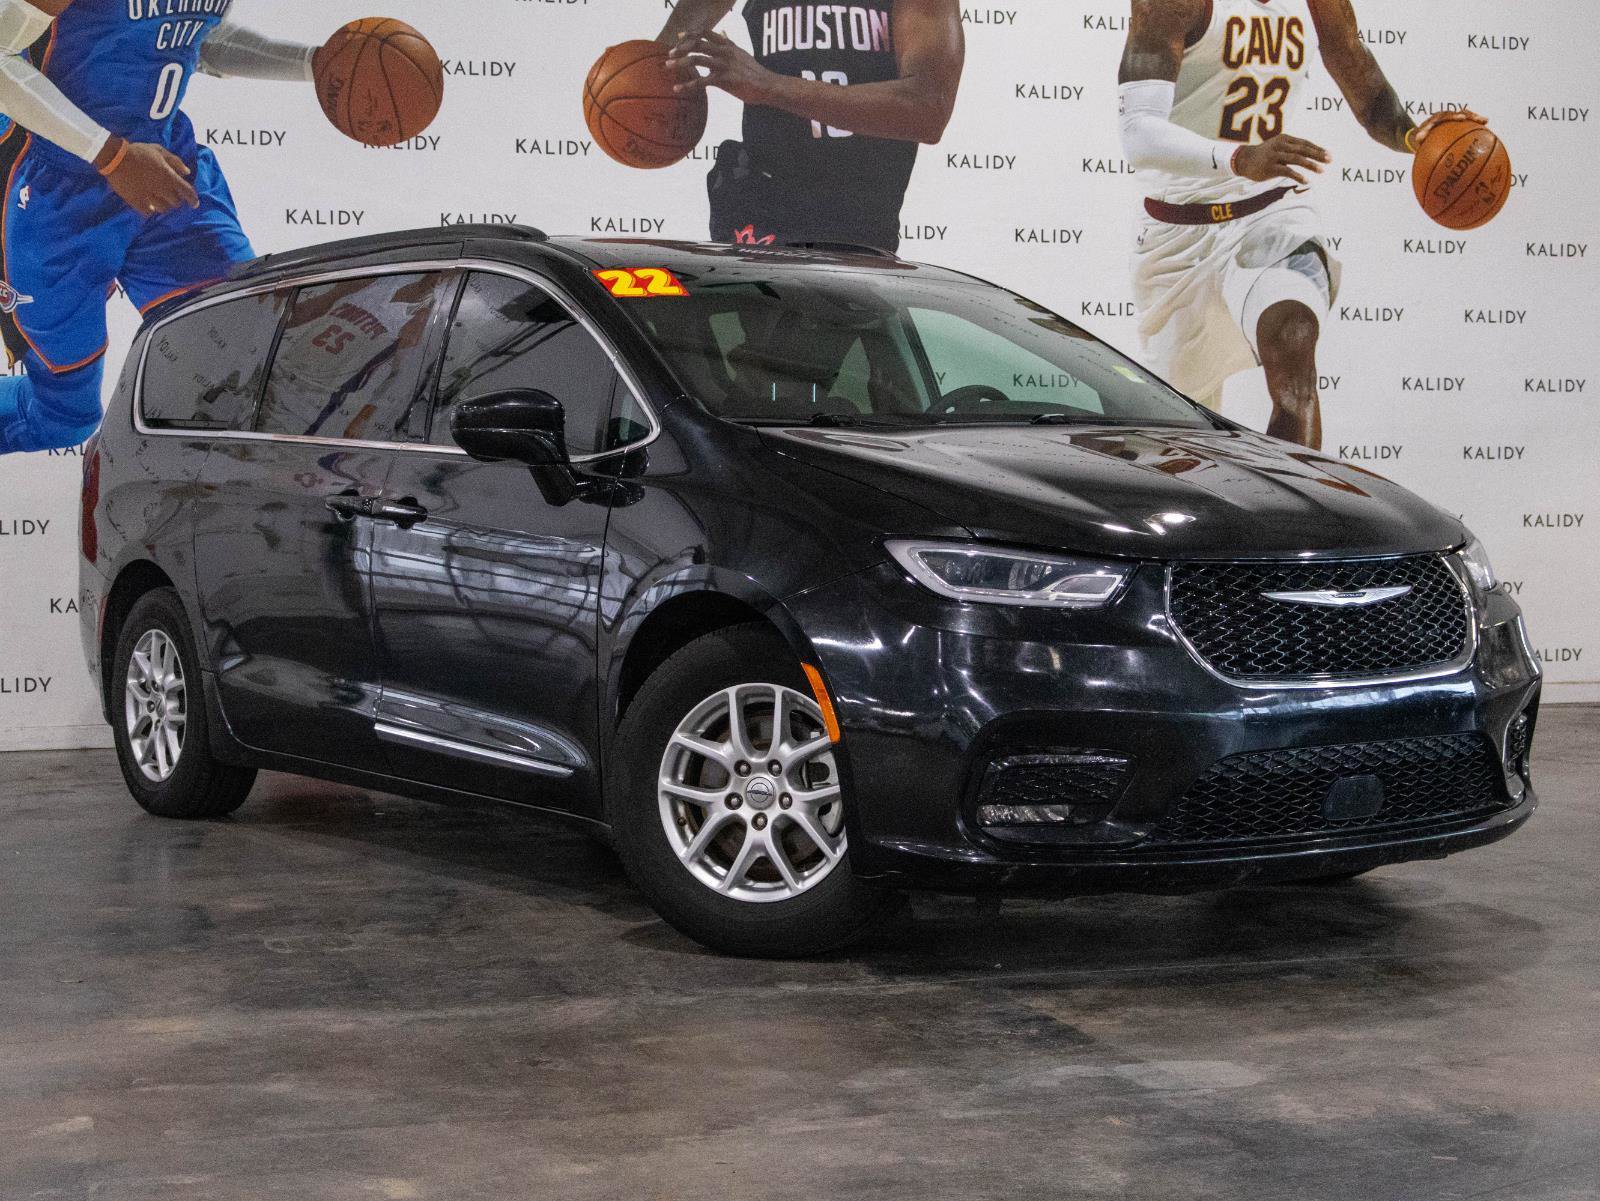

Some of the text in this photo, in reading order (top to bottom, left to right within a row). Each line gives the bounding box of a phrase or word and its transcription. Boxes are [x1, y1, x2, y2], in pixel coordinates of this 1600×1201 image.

[961, 9, 1017, 25] ALIDY
[1083, 15, 1133, 31] KALI
[156, 20, 204, 50] CITY
[763, 5, 890, 57] HOUSTON
[1355, 30, 1407, 45] ALIDY
[1222, 15, 1304, 71] CAVS
[1468, 34, 1529, 50] KALIDY
[441, 59, 516, 76] KALIDY
[1016, 84, 1084, 100] KALIDY
[1217, 76, 1291, 143] 23
[1528, 106, 1589, 122] KALIDY
[206, 129, 286, 146] KALIDY
[515, 138, 592, 156] KALIDY
[948, 154, 1016, 170] KALIDY
[1343, 168, 1405, 183] KALIDY
[286, 209, 364, 225] KALIDY
[1211, 203, 1233, 221] CLE
[591, 217, 664, 233] KALIDY
[898, 225, 947, 240] LIDY
[1015, 229, 1082, 244] KALIDY
[1404, 239, 1466, 254] KALIDY
[1527, 243, 1587, 257] KALIDY
[597, 268, 681, 296] 22
[1081, 302, 1135, 316] KALID
[1341, 307, 1403, 321] KALIDY
[1465, 309, 1526, 323] KALIDY
[1013, 373, 1079, 388] KALIDY
[1403, 377, 1464, 391] KALIDY
[1525, 379, 1585, 392] KALIDY
[1339, 445, 1403, 460] KALIDY
[1464, 446, 1525, 459] KALIDY
[0, 519, 50, 535] LIDY
[1524, 514, 1583, 527] KALIDY
[1535, 648, 1583, 662] ALIDY
[0, 677, 52, 693] LIDY
